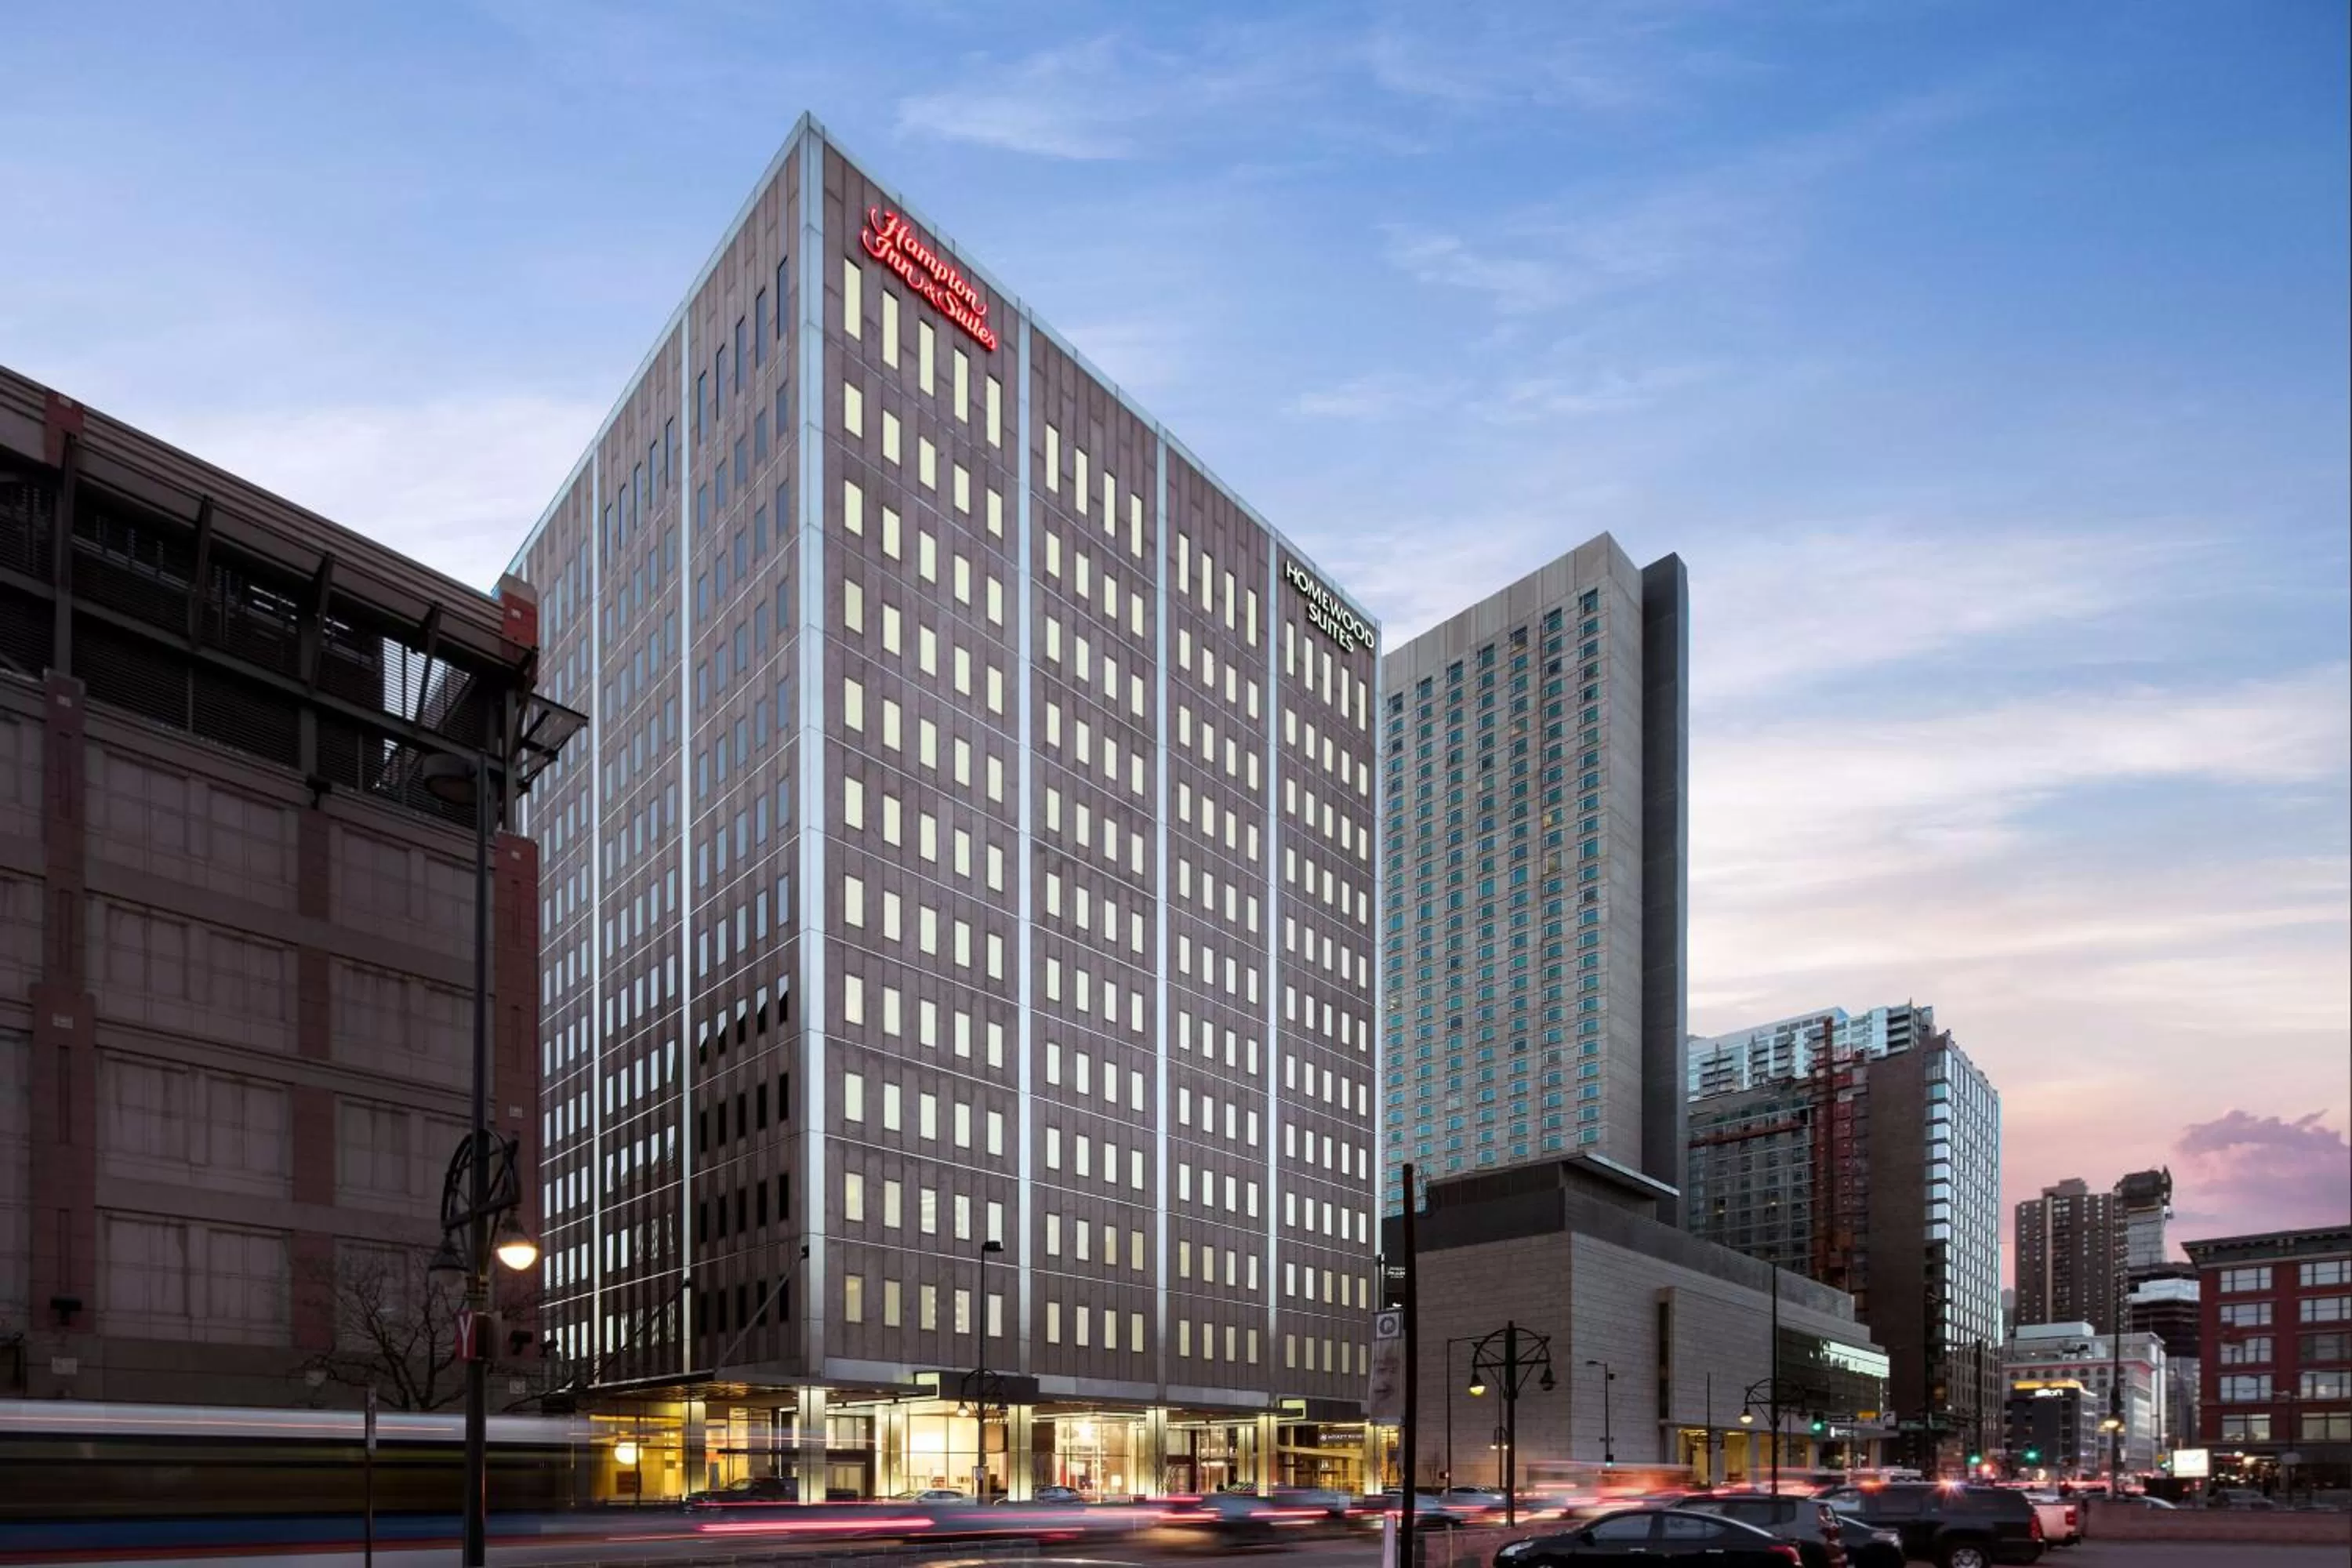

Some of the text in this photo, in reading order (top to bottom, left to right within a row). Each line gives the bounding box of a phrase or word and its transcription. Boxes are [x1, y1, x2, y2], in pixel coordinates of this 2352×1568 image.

[862, 229, 924, 289] Inn
[936, 290, 997, 350] Suites
[869, 207, 987, 316] Hampton
[1287, 561, 1374, 648] HOMEWOOD
[1308, 603, 1354, 652] SUITES
